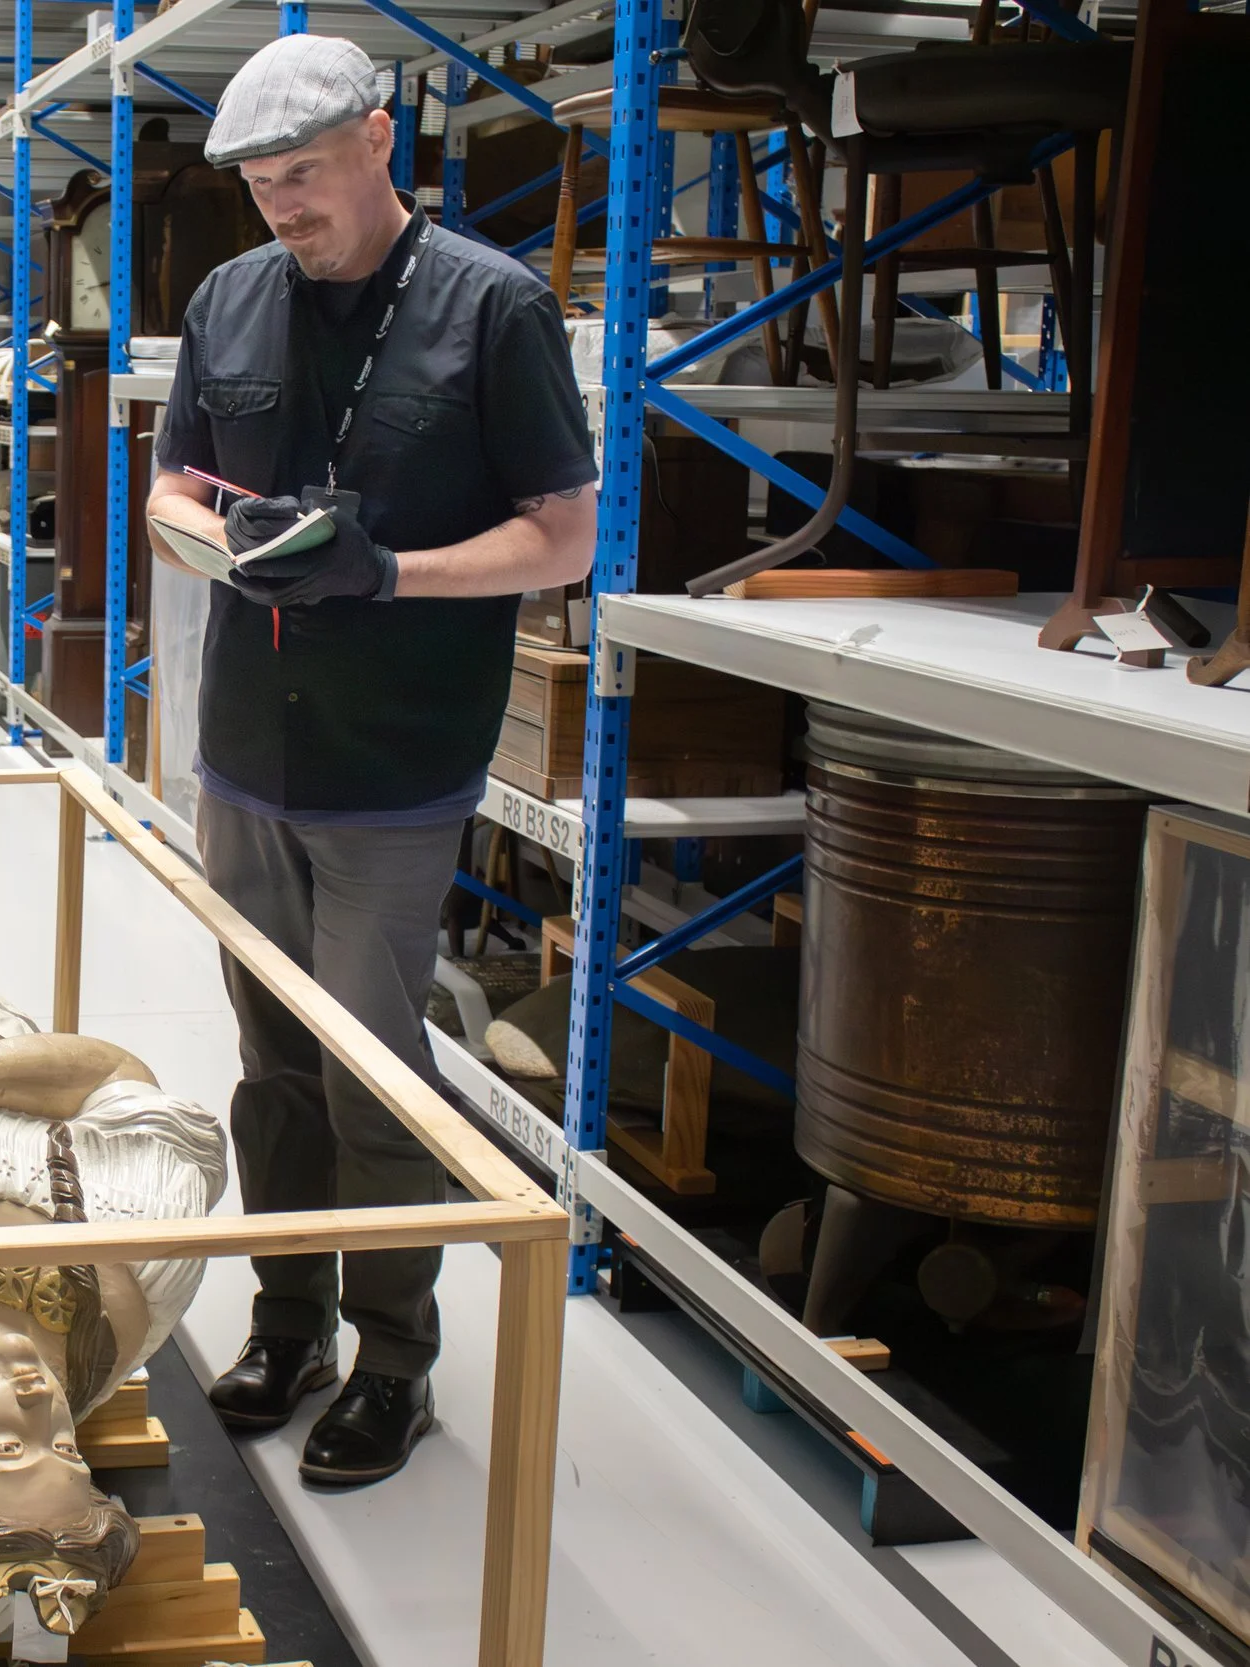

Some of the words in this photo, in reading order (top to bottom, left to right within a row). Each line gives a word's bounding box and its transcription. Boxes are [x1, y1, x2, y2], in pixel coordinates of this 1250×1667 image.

[503, 792, 521, 829] R8
[526, 803, 545, 842] B3
[550, 816, 570, 854] S2
[490, 1086, 507, 1126] R8
[512, 1103, 530, 1145] B3
[534, 1124, 552, 1165] S1
